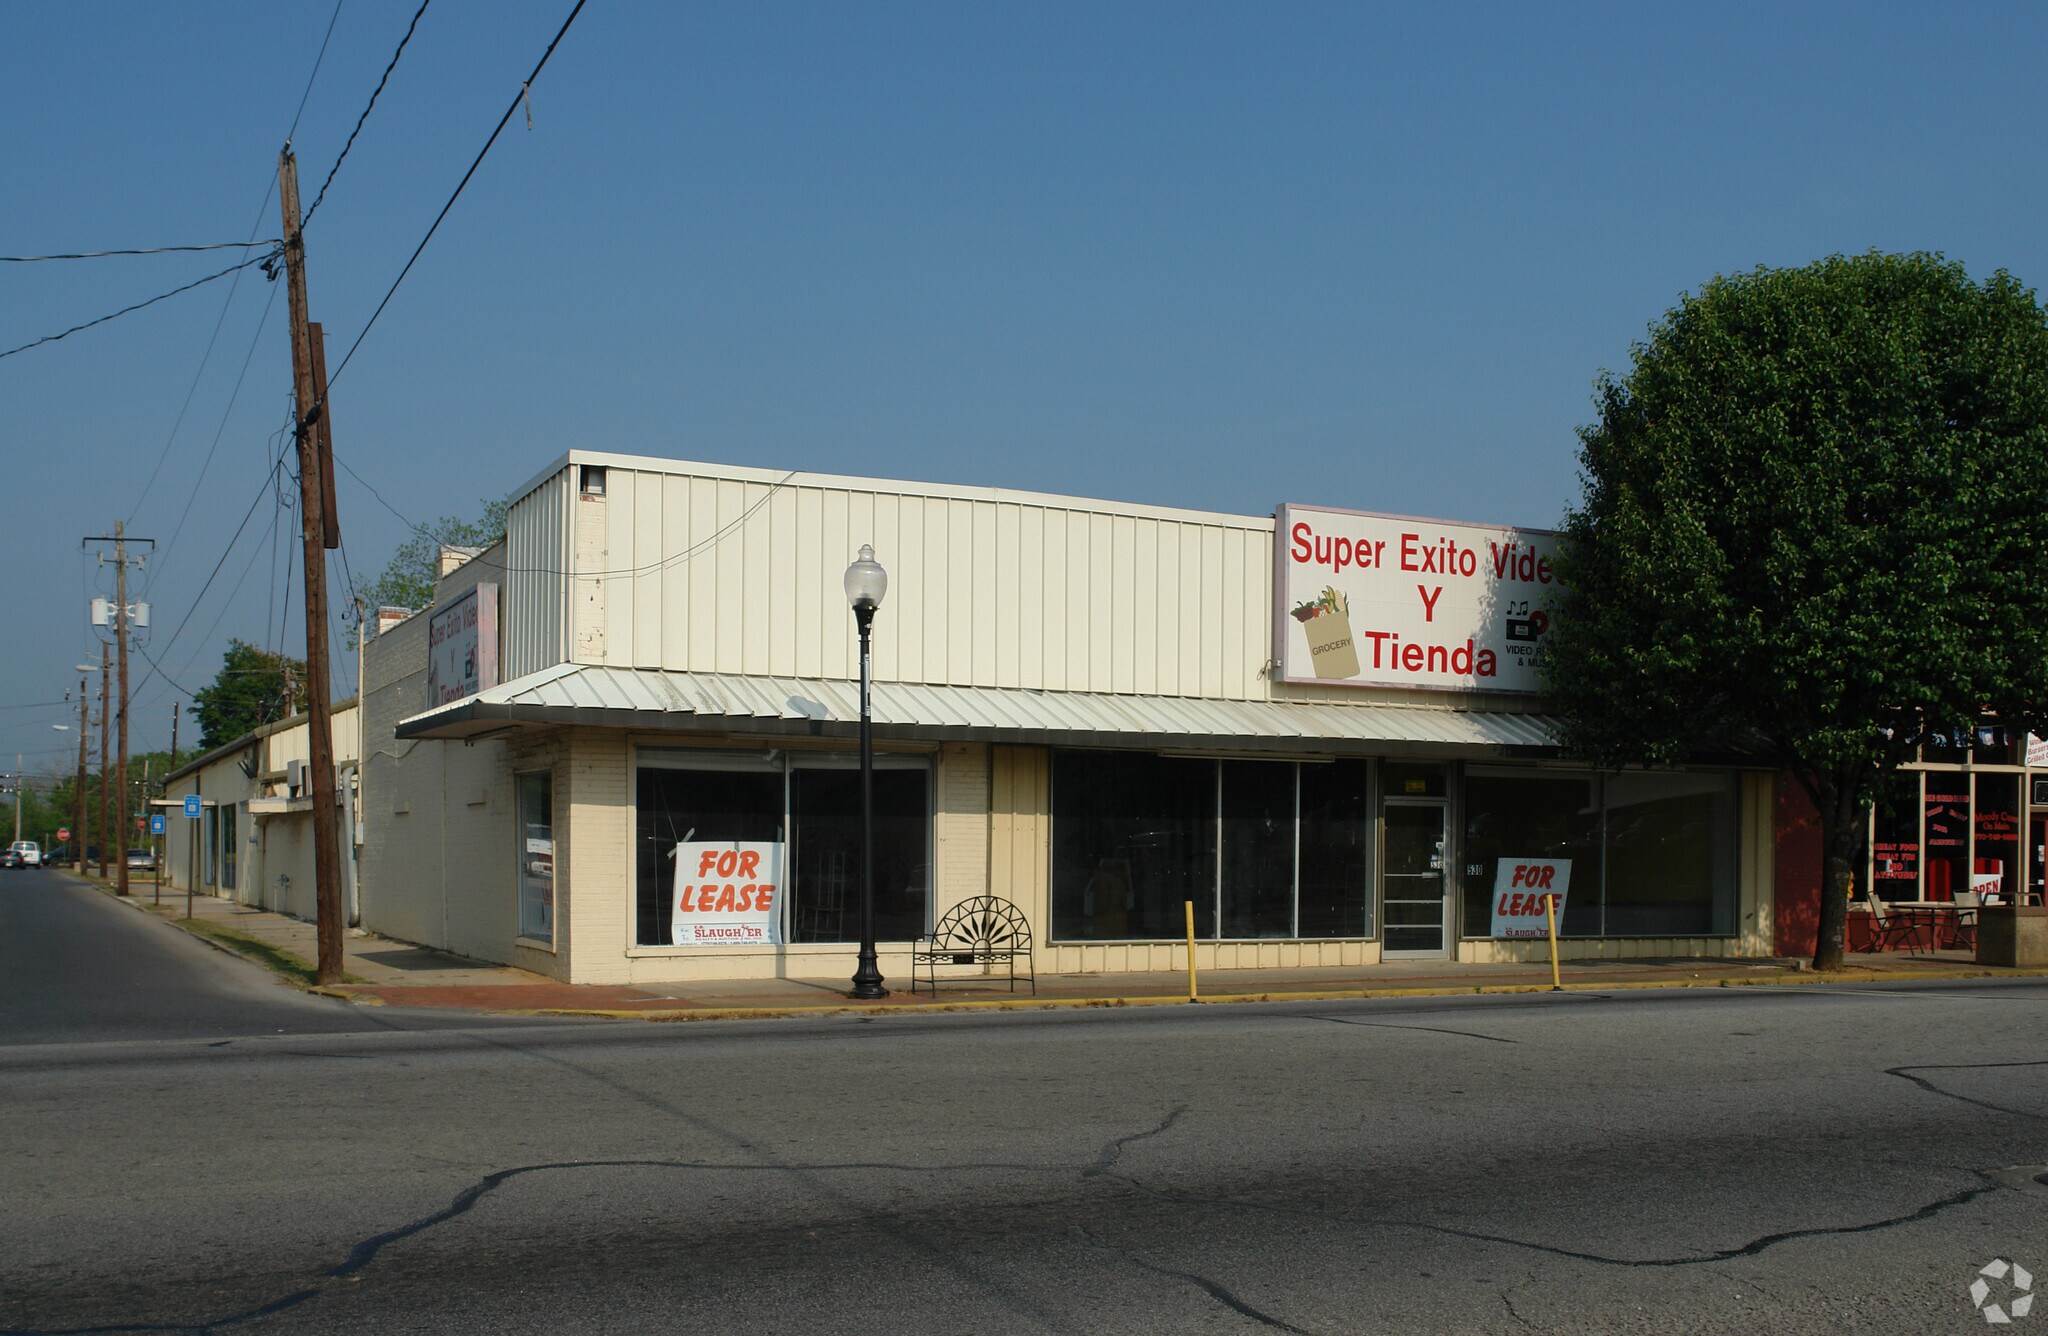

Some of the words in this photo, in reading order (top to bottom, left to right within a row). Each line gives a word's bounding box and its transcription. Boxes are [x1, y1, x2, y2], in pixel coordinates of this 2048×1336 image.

[1291, 522, 1386, 573] Super
[1400, 533, 1477, 577] Exito
[1490, 541, 1567, 586] Vide
[1417, 584, 1443, 622] Y
[1312, 637, 1352, 656] GROCERY
[1365, 630, 1497, 677] Tienda
[1506, 645, 1533, 656] VIDEO
[1517, 657, 1524, 667] &
[698, 849, 760, 880] FOR
[1467, 864, 1483, 876] 530
[1511, 864, 1556, 889] FOR
[680, 884, 776, 913] LEASE
[1497, 892, 1563, 916] LEASE
